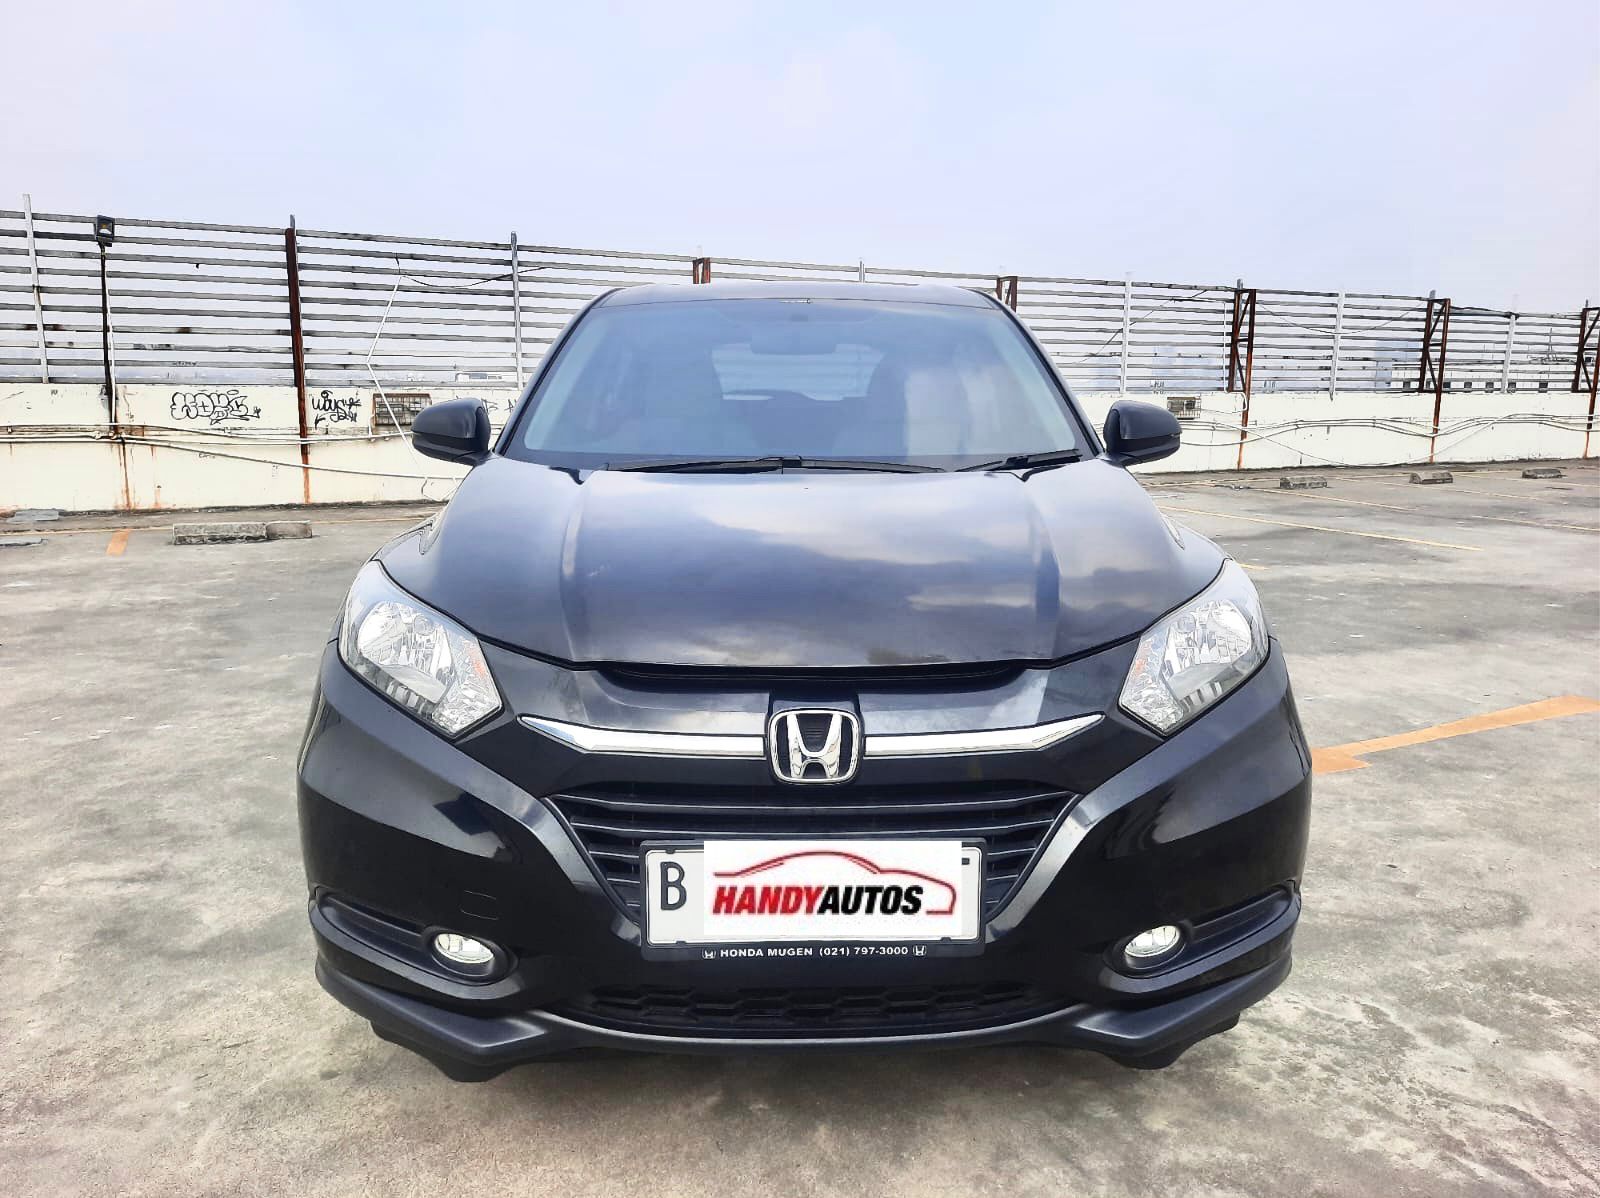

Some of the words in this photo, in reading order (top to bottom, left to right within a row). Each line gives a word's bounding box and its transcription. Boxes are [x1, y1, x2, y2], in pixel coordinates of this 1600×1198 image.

[660, 861, 687, 911] B
[720, 948, 764, 958] HONDA
[767, 947, 813, 957] MUGEN
[819, 947, 850, 956] (021)
[854, 946, 908, 955] 797-3000
